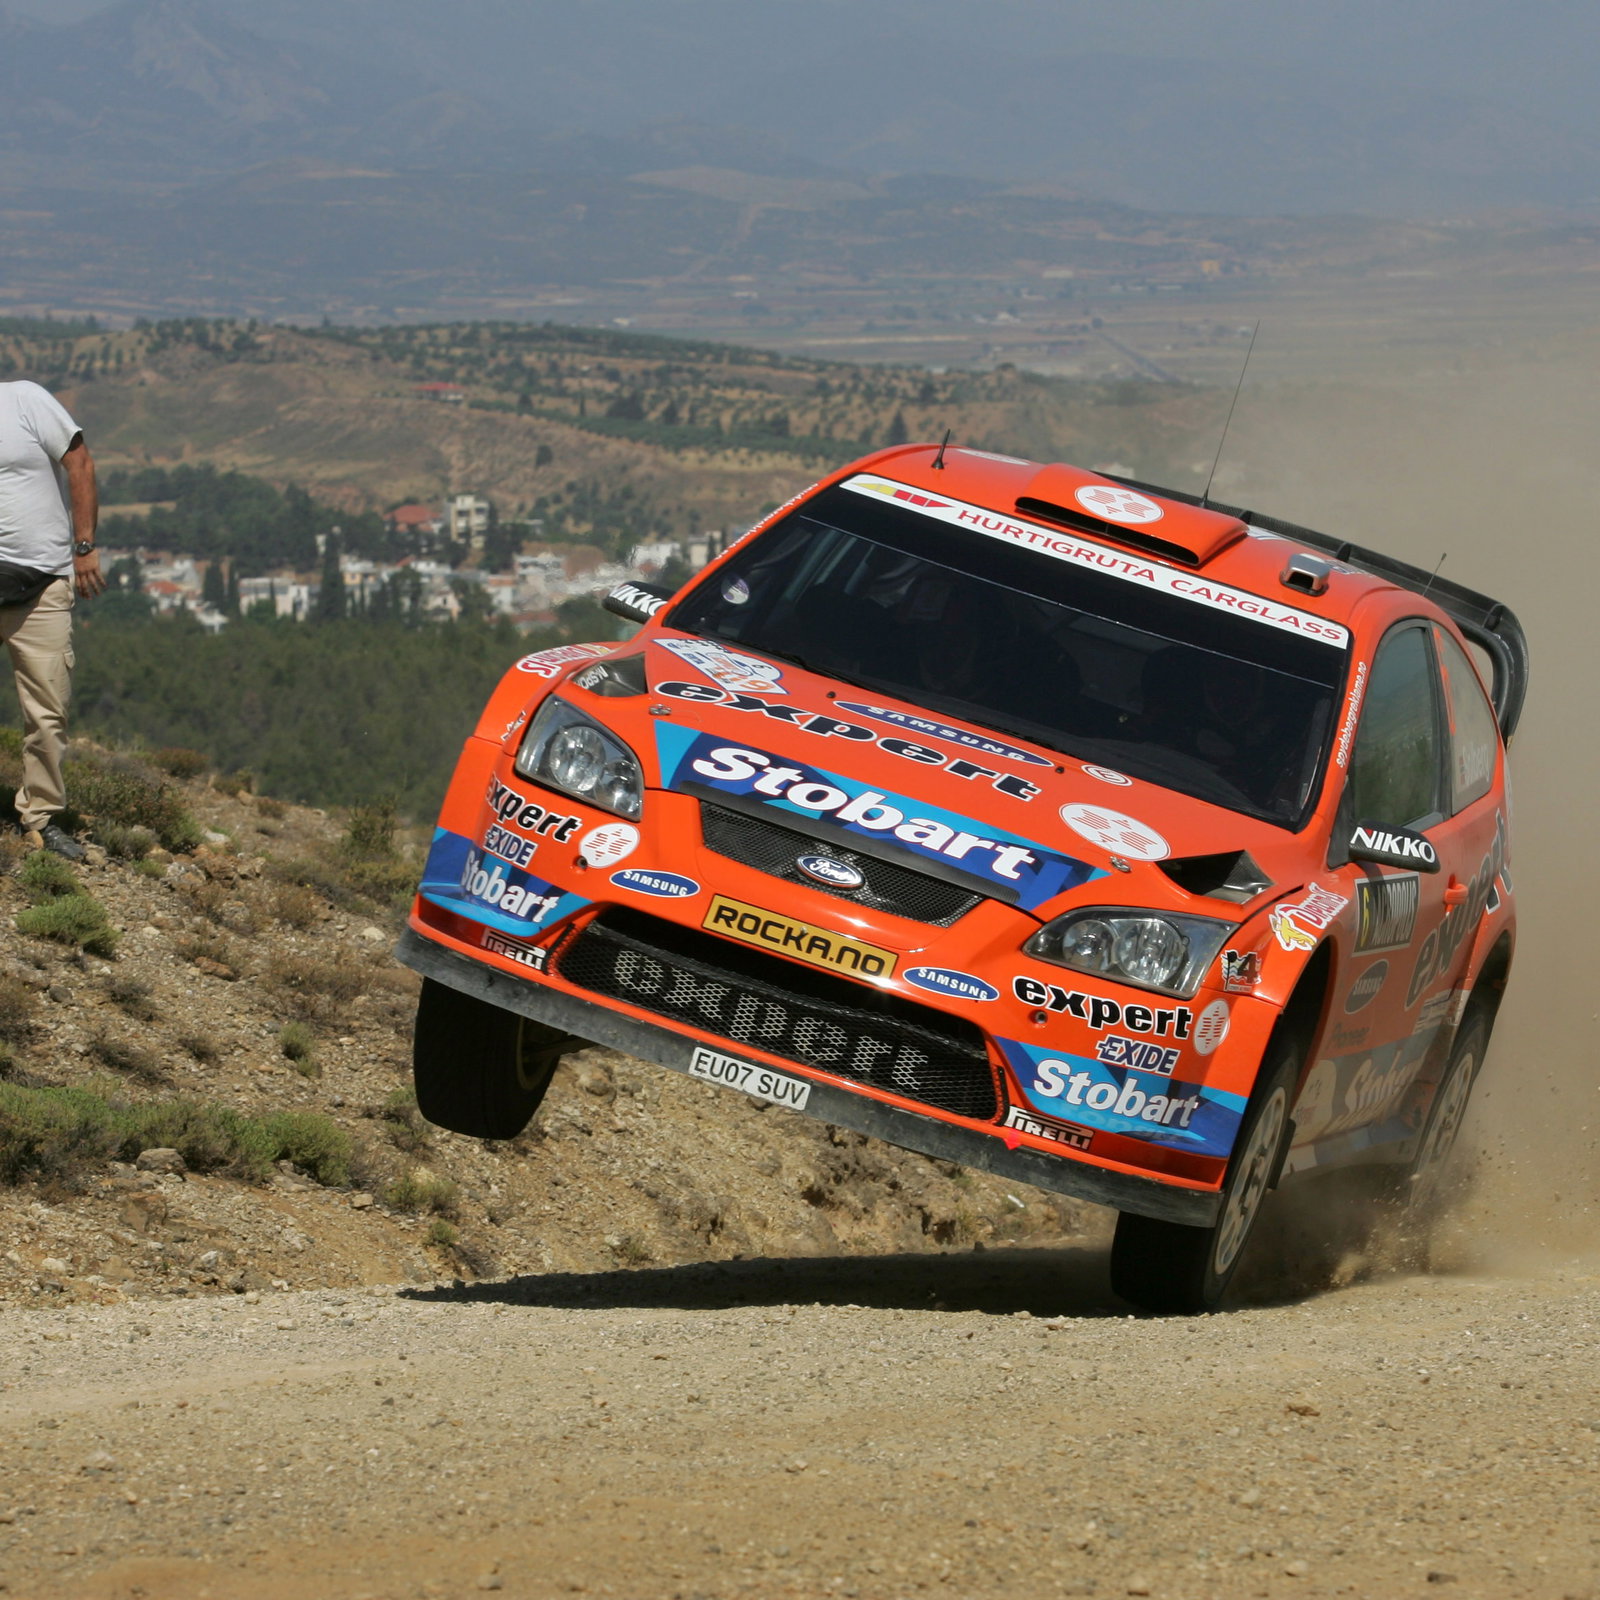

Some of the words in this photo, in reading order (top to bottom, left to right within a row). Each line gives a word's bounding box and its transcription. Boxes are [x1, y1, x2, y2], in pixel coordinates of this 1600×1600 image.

[957, 509, 1156, 583] HURTIGRUTA
[1171, 579, 1343, 642] CARGLASS
[655, 682, 1042, 802] expert
[867, 706, 1026, 762] SAMSUNG
[1336, 661, 1367, 768] spydebergreklame.no
[693, 747, 1035, 880] Stobart
[485, 825, 539, 868] EXIDE
[811, 857, 860, 883] Ford
[1351, 826, 1436, 864] NIKKO
[460, 851, 560, 923] Stobart
[622, 869, 689, 897] SAMSUNG
[481, 929, 546, 970] PIRELLI
[711, 903, 887, 974] ROCKA.NO
[917, 967, 988, 1001] SAMSUNG
[1013, 975, 1194, 1040] expert
[613, 949, 929, 1091] expert
[693, 1054, 751, 1090] EU07
[757, 1073, 806, 1104] SUV
[1097, 1035, 1180, 1076] EXIDE
[1034, 1058, 1200, 1128] Stobart
[1004, 1106, 1092, 1149] PIRELLI
